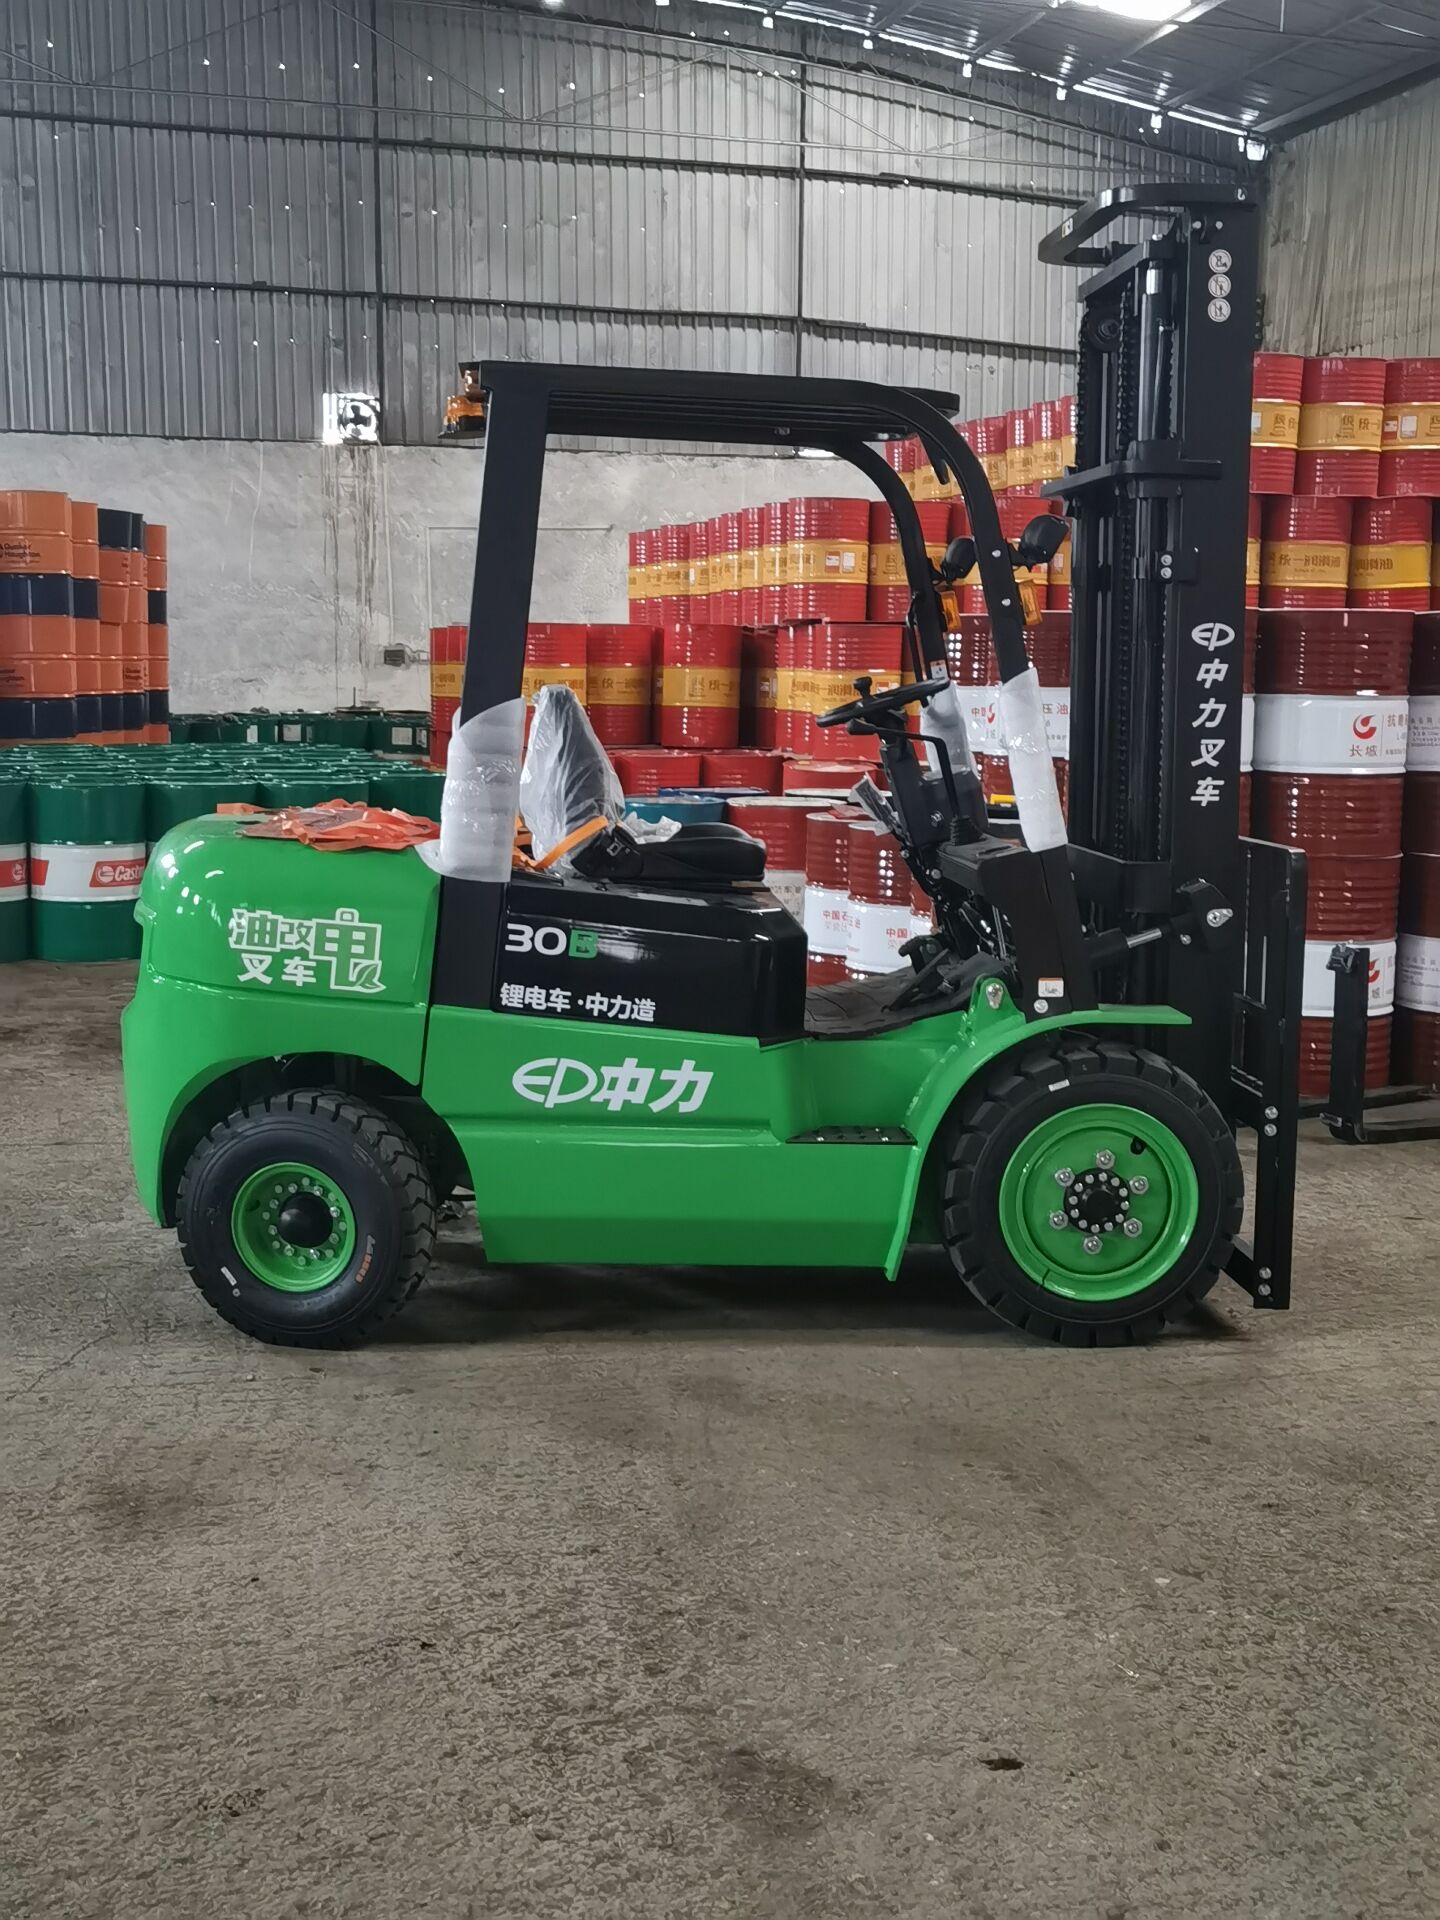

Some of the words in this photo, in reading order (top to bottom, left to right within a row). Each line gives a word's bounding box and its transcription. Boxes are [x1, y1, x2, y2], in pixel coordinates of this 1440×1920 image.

[1190, 658, 1229, 807] 中力叉车
[237, 952, 317, 987] 叉车
[590, 1057, 714, 1113] 中力
